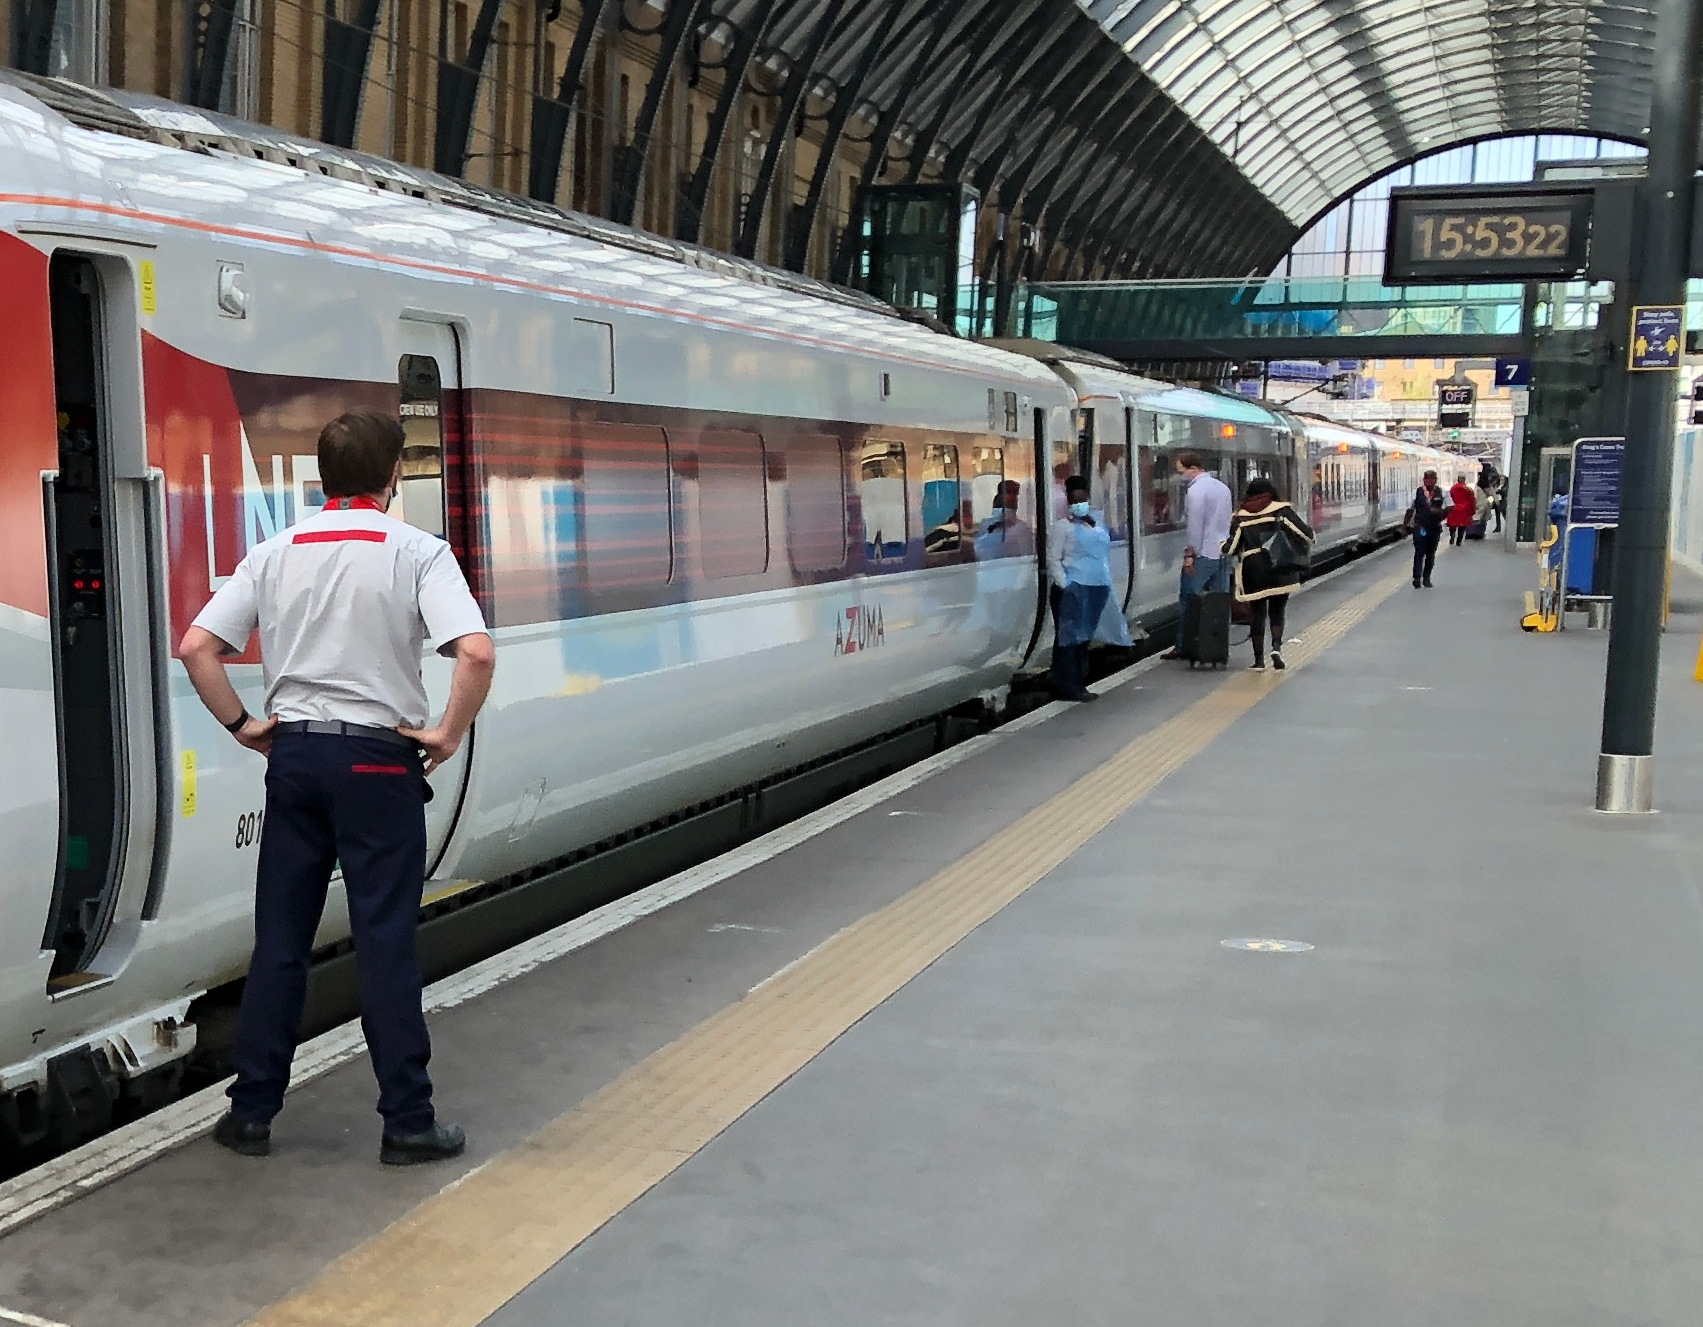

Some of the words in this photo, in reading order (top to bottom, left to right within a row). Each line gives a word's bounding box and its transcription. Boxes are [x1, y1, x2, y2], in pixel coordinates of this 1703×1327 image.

[1505, 364, 1519, 380] 7
[1445, 391, 1468, 402] OFF
[833, 602, 885, 657] AZUMA
